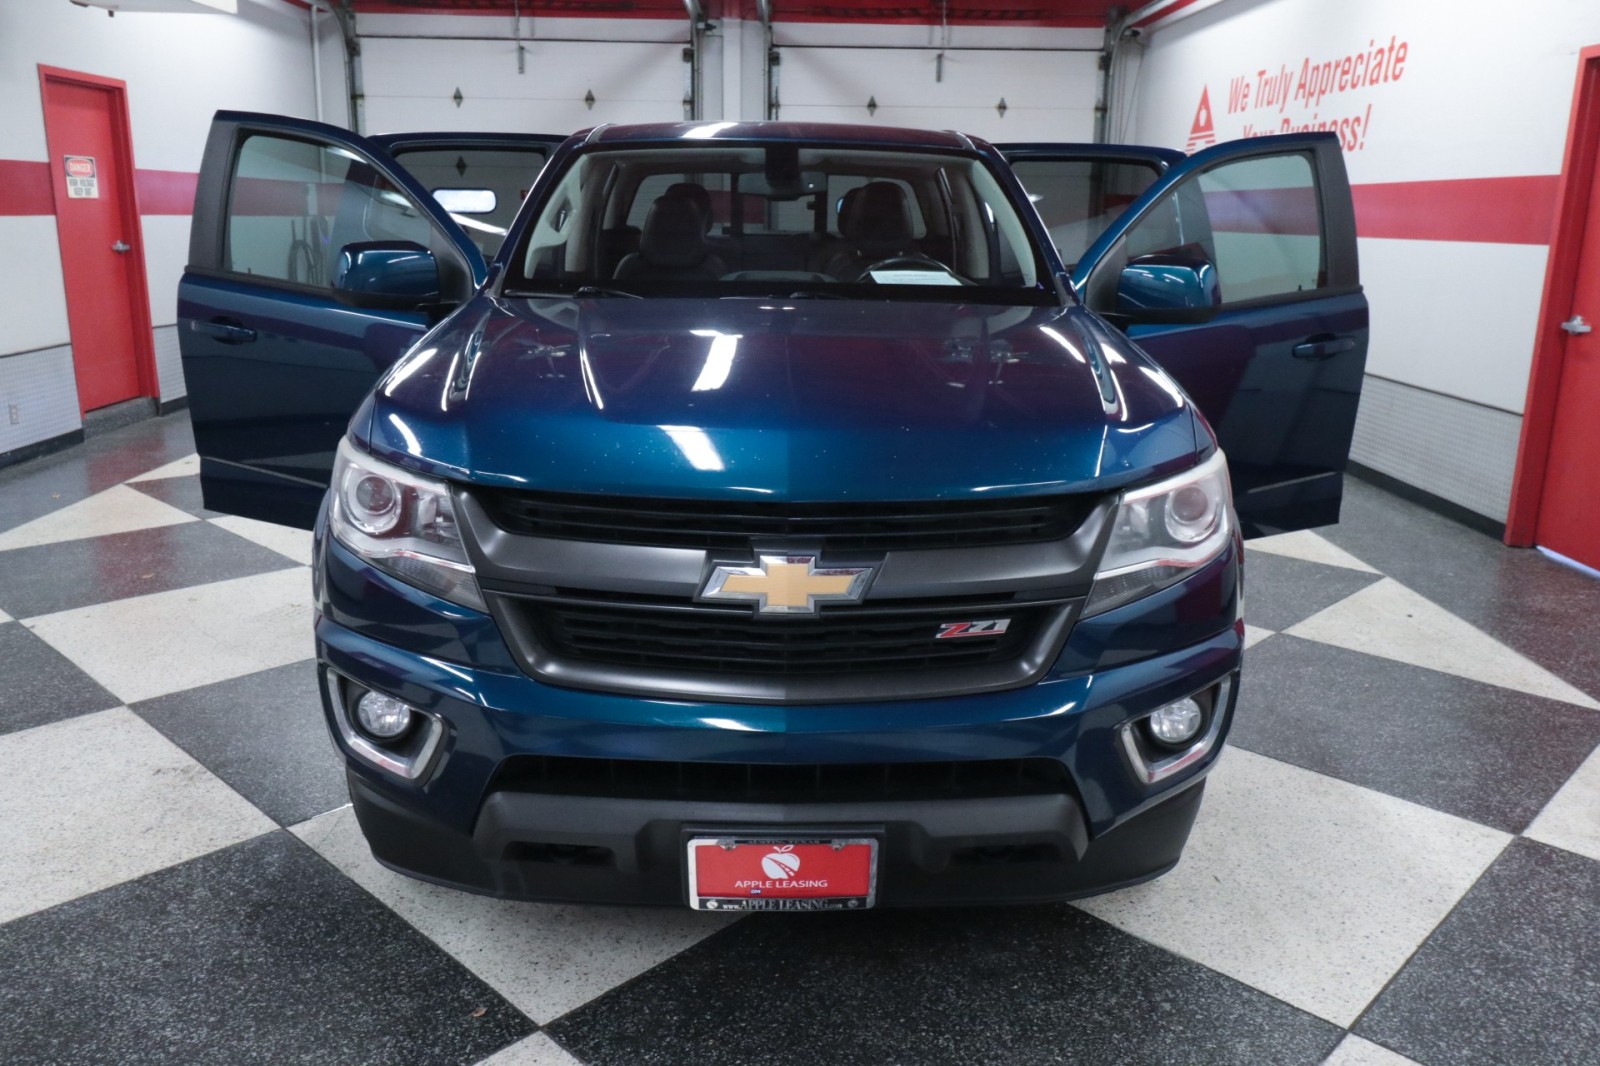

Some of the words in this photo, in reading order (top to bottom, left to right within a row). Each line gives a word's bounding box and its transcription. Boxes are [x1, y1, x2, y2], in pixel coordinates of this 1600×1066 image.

[1228, 75, 1250, 114] We
[1254, 64, 1294, 113] Truly
[1294, 35, 1408, 109] Appreciate
[935, 618, 1011, 638] Z71
[734, 880, 773, 889] APPLE
[775, 879, 829, 888] LEASING
